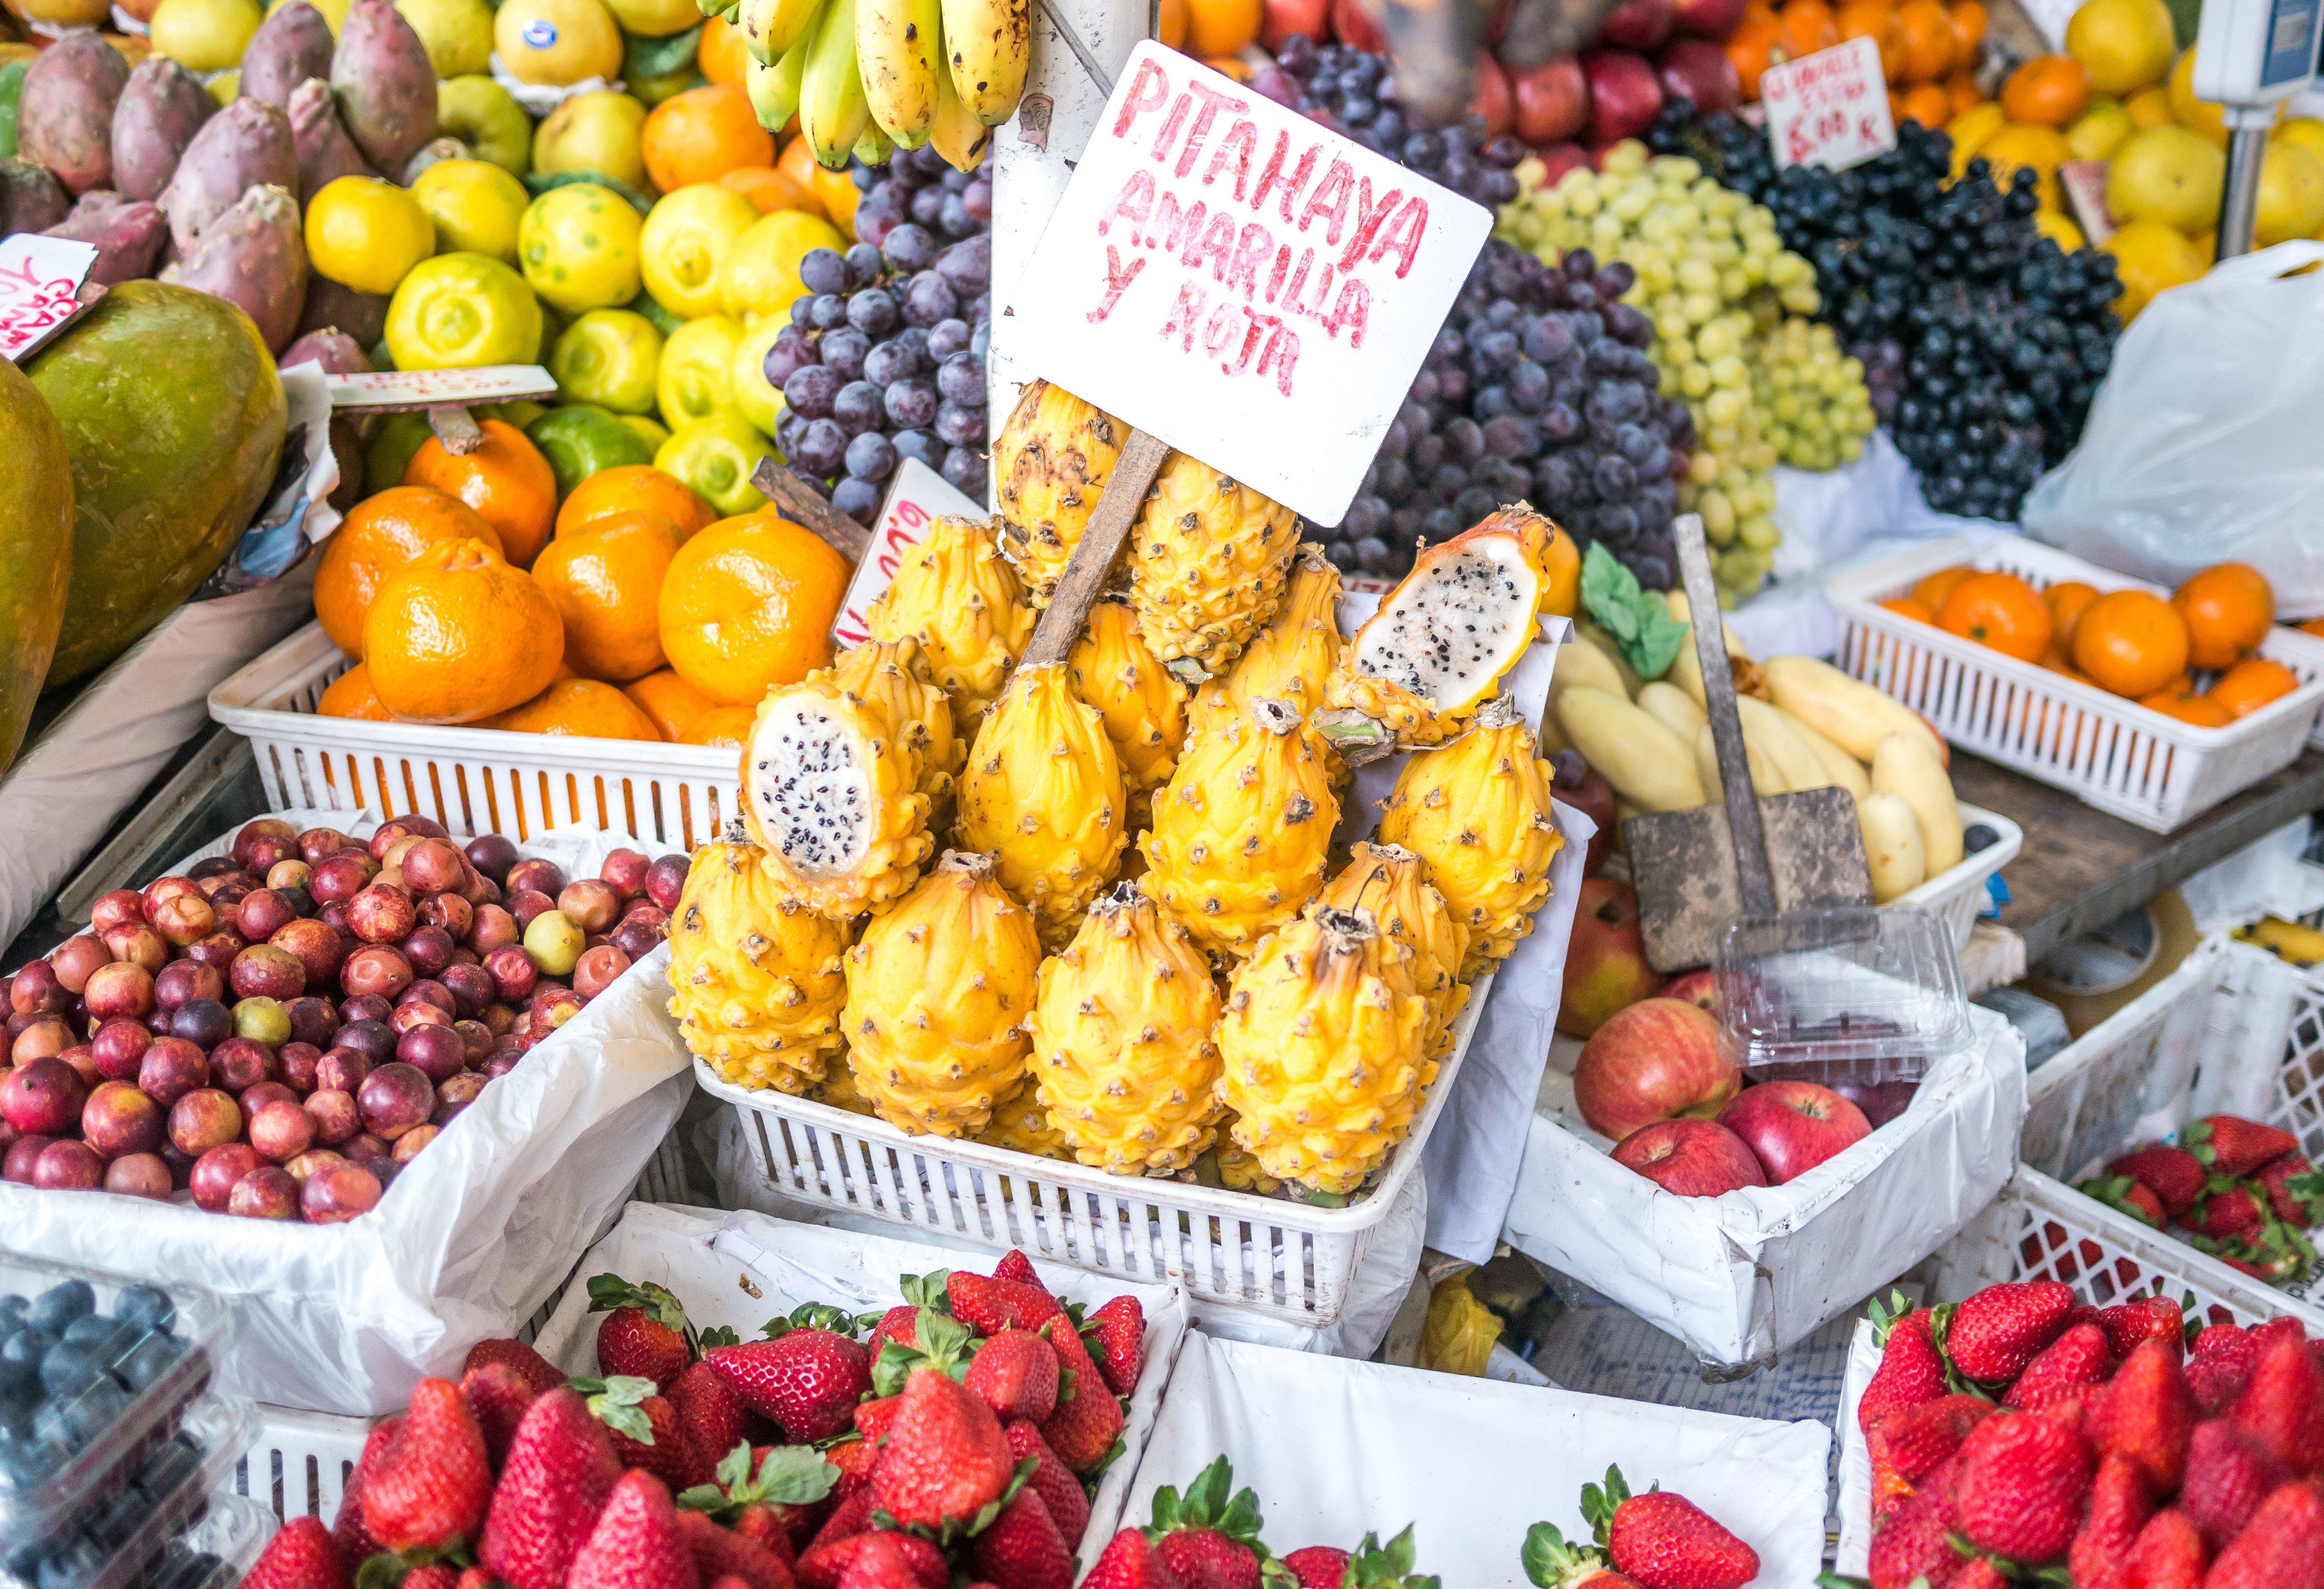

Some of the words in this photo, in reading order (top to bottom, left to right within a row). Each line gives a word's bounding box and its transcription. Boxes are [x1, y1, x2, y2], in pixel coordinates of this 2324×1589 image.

[1113, 57, 1429, 279] PITAHAYA
[0, 298, 79, 351] CAM
[1086, 245, 1146, 324] Y
[1159, 279, 1300, 397] ROJA
[1098, 169, 1370, 349] AMARILLA
